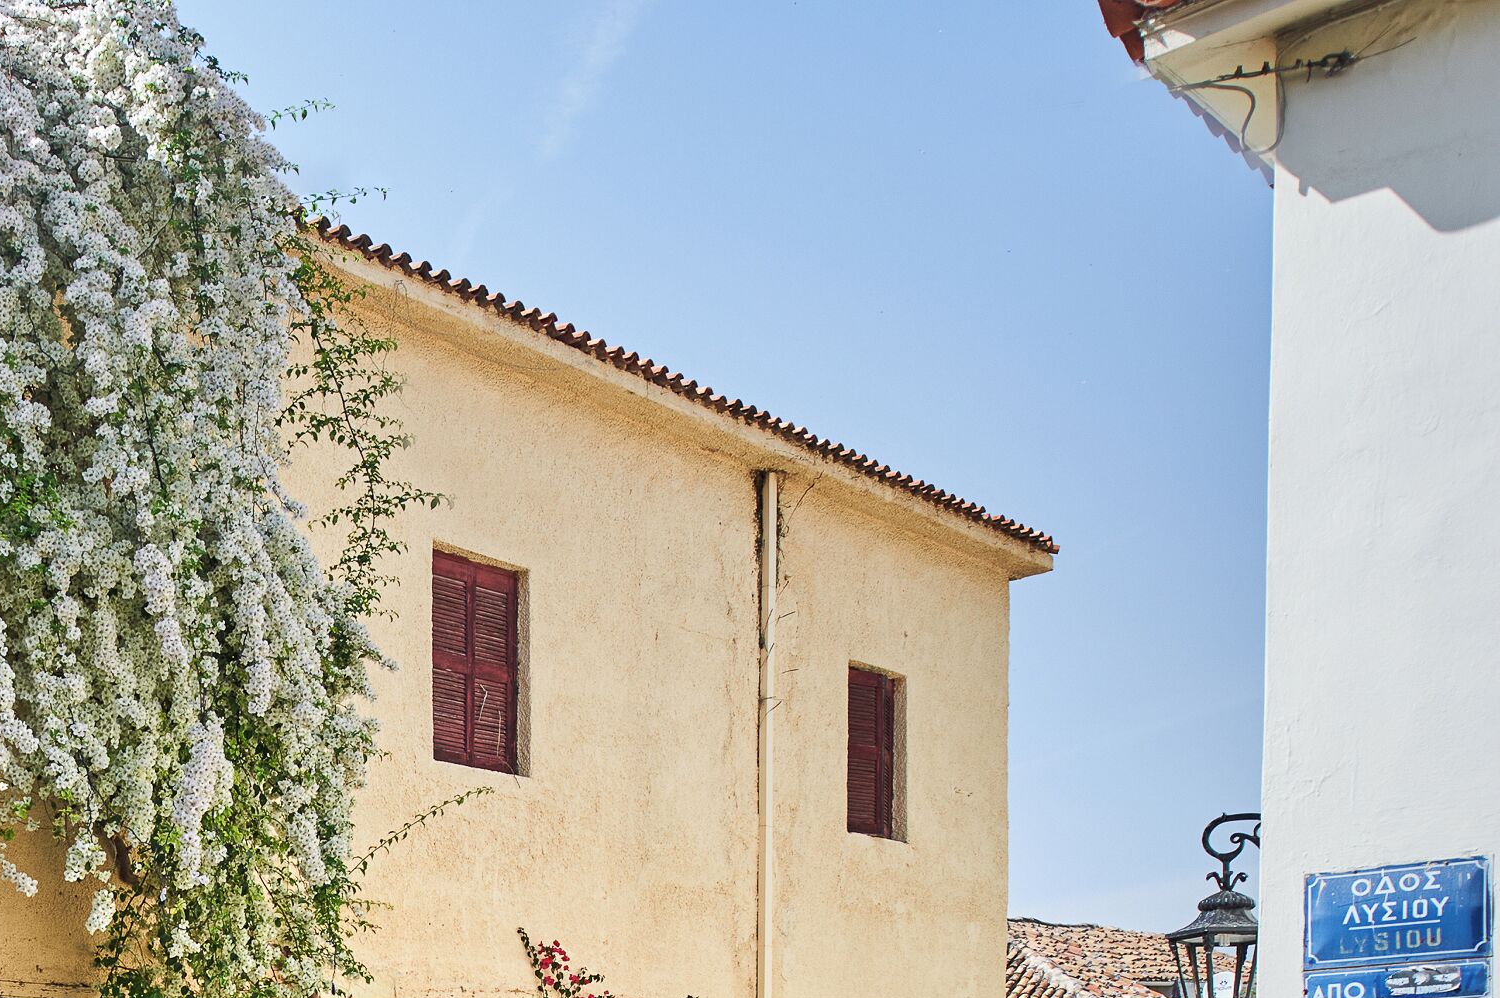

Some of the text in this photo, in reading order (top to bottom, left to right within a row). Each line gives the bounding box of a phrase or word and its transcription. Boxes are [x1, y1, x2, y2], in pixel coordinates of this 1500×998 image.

[1351, 869, 1442, 897] ΟΔΟΣ
[1342, 896, 1450, 926] ΛΥΣΙΟΥ
[1339, 927, 1442, 954] LYSIOU
